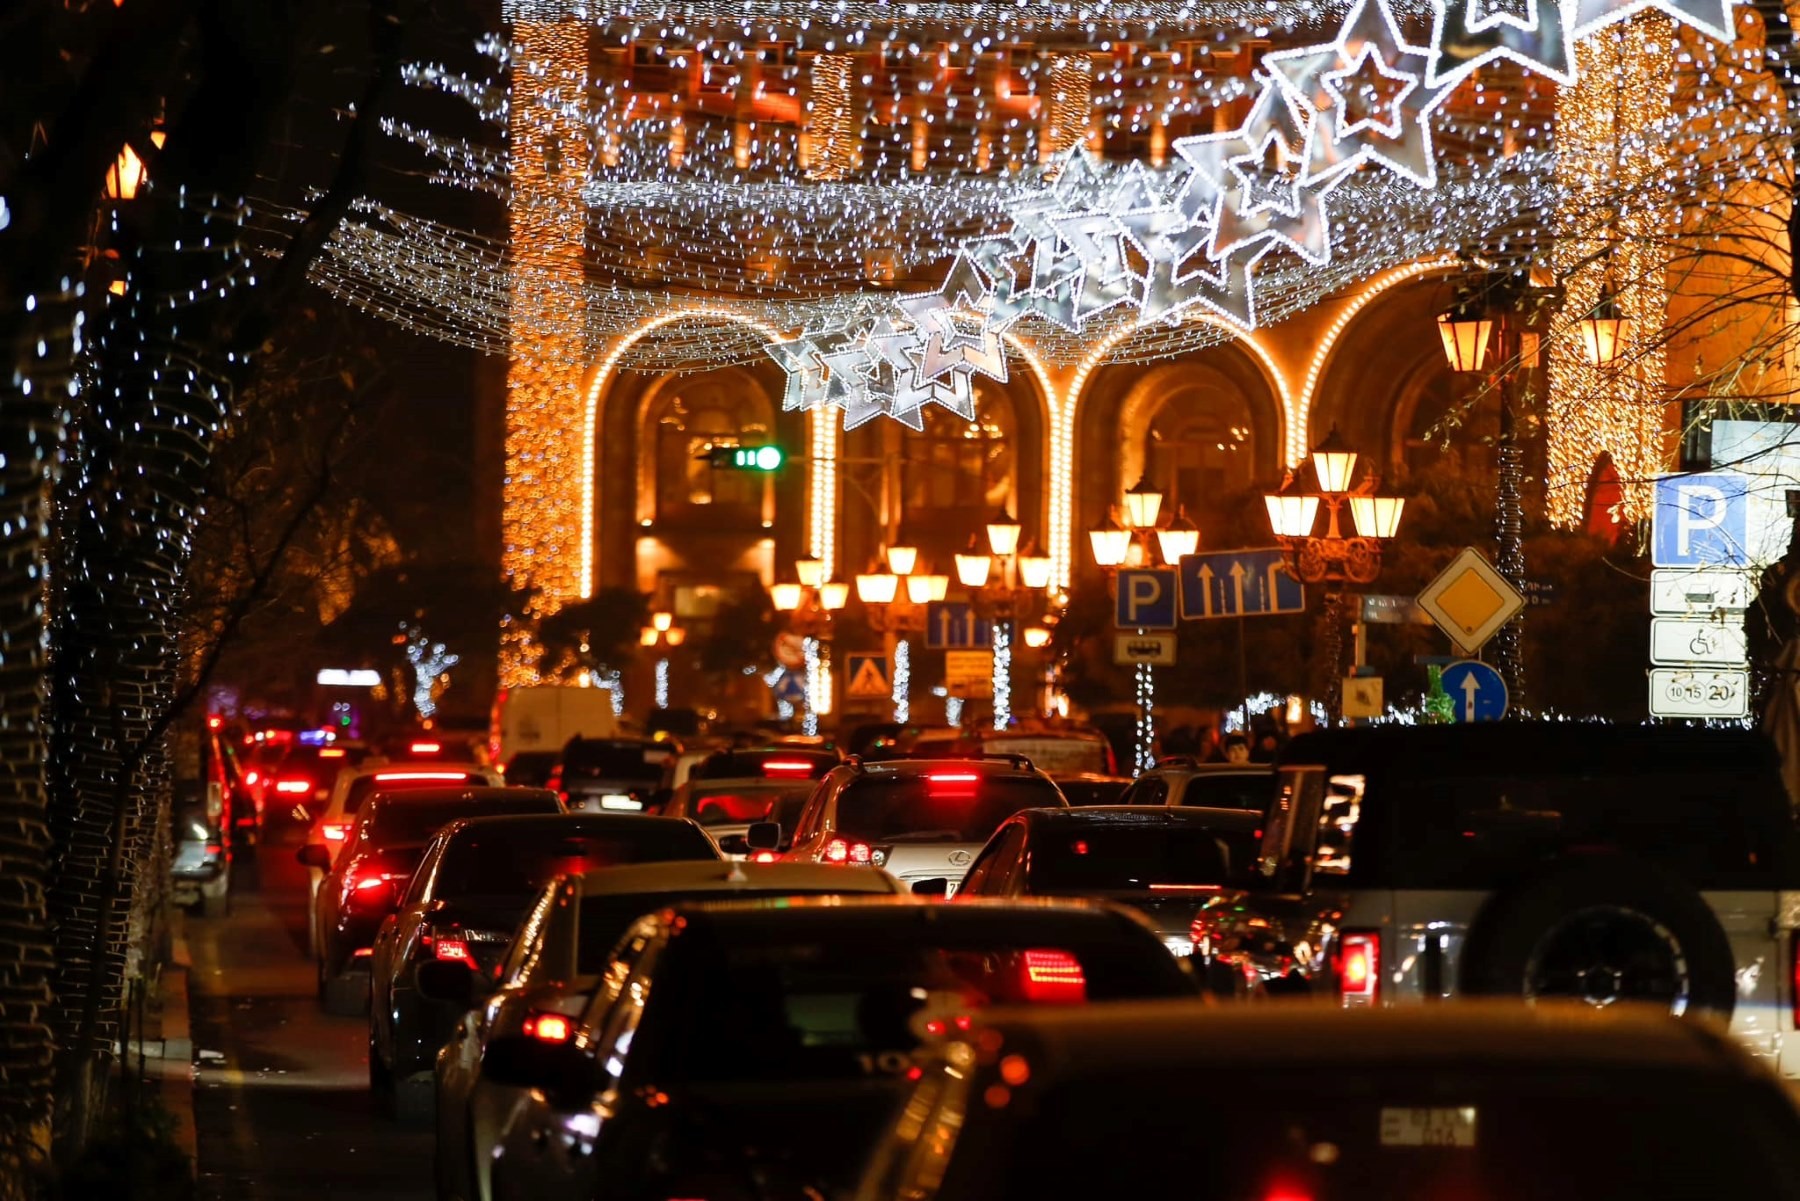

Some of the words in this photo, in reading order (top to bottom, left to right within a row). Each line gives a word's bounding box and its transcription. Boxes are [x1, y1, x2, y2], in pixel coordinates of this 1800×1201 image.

[1677, 485, 1727, 557] P
[1128, 575, 1161, 621] P
[1671, 687, 1682, 697] 10
[1687, 687, 1702, 699] 15
[1708, 685, 1729, 701] 20
